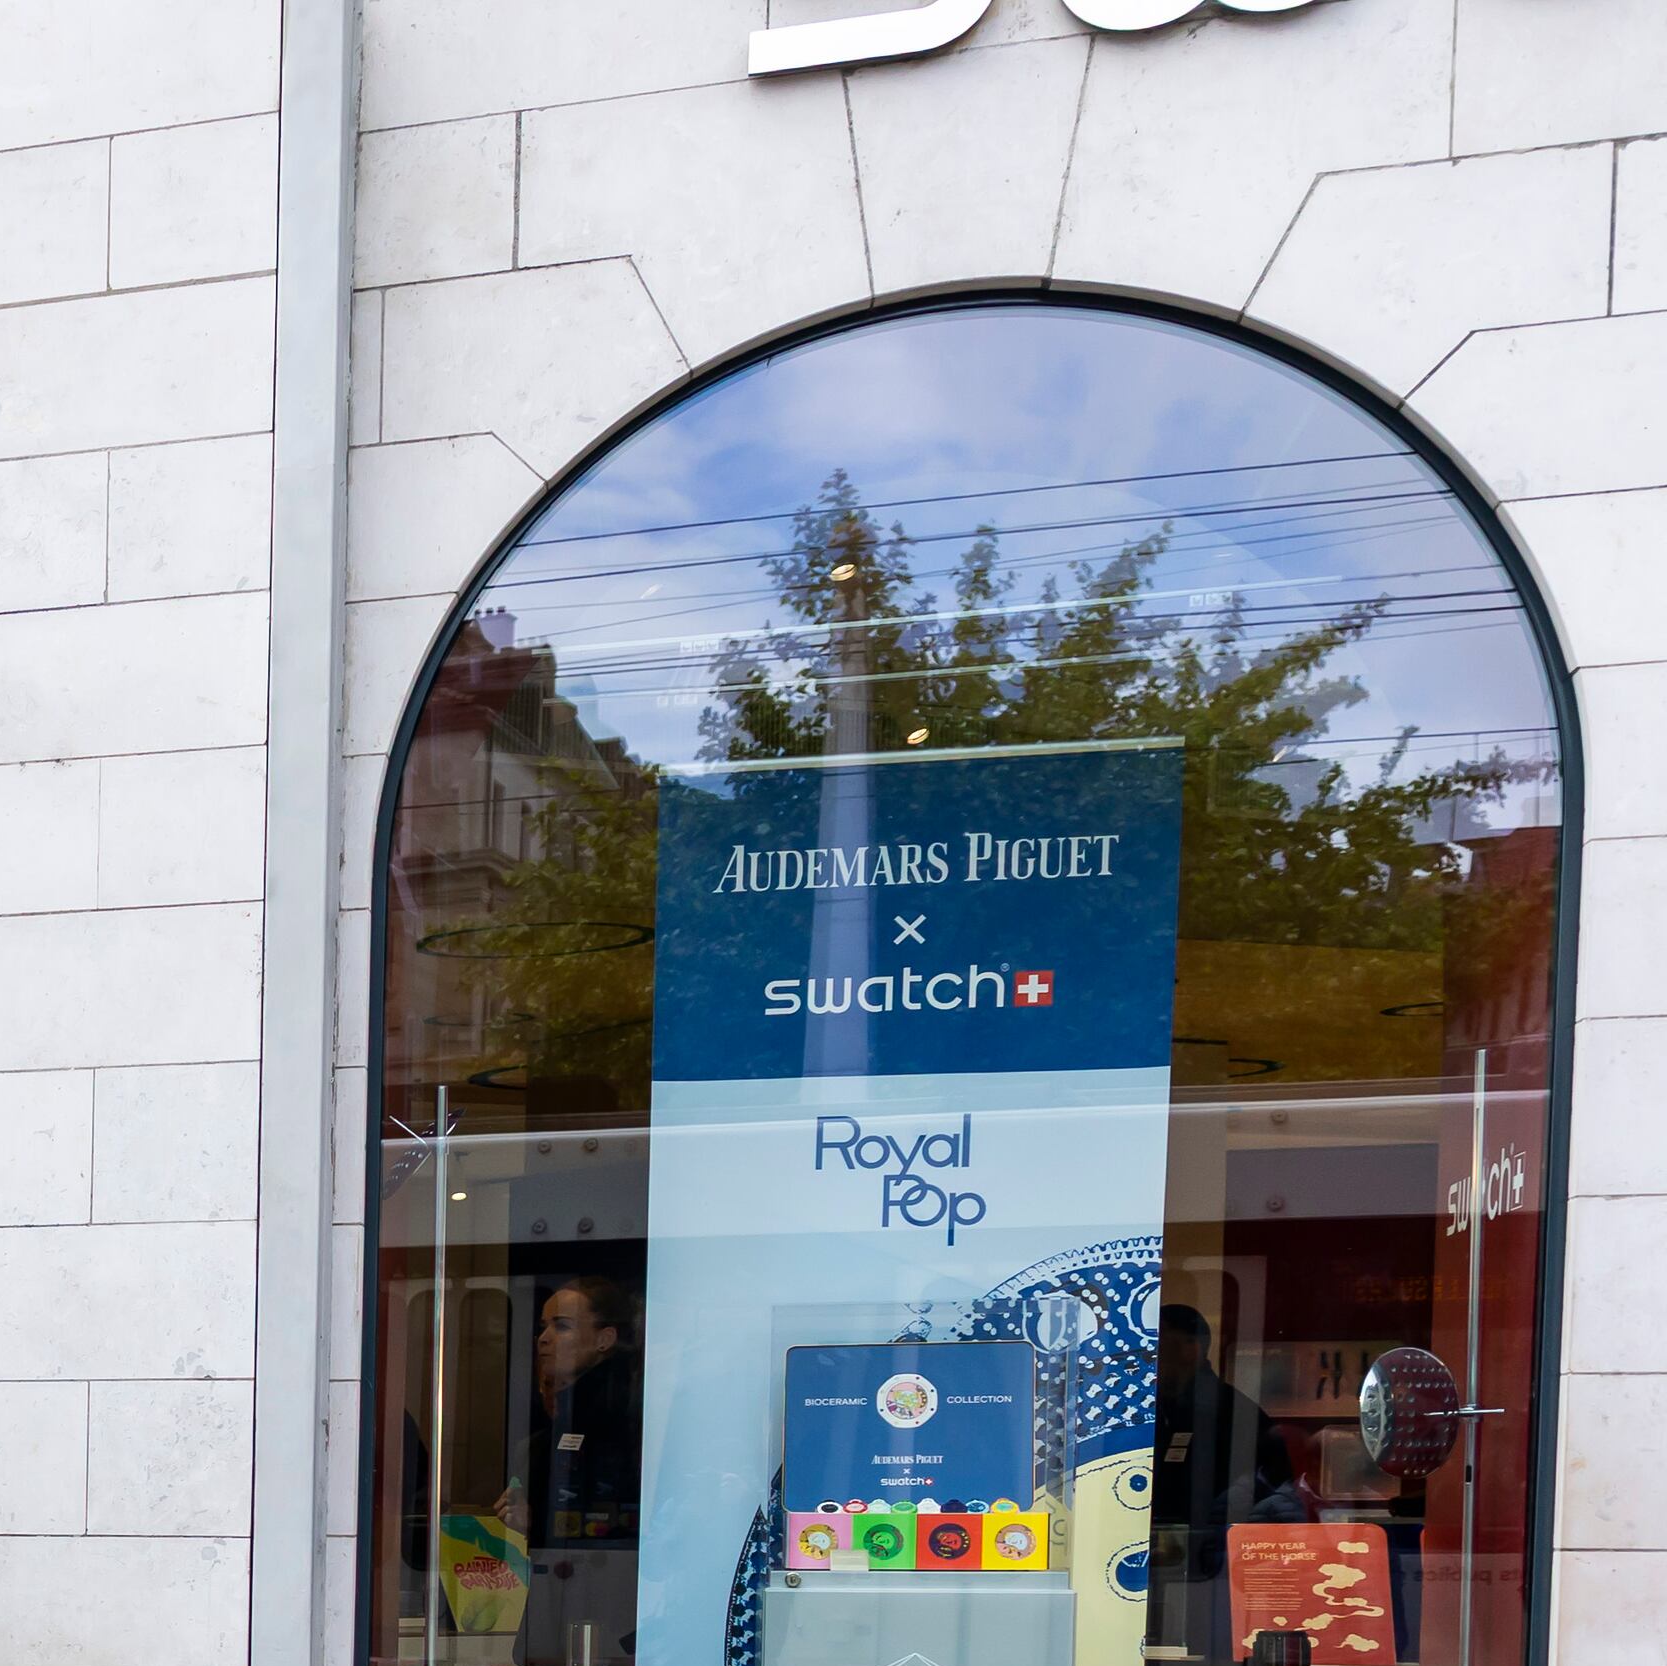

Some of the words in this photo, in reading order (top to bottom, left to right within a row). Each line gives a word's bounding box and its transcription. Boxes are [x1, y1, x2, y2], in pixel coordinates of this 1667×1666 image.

[713, 843, 950, 895] AUDEMARS
[962, 832, 1120, 882] PIGUET
[815, 1113, 971, 1186] Royal
[1446, 1148, 1512, 1236] swch
[804, 1396, 868, 1407] BIOCERAMIC
[946, 1395, 1013, 1405] COLLECTION
[916, 1453, 944, 1464] PIGUET
[880, 1477, 925, 1486] swatch
[1242, 1542, 1276, 1550] HAPPY
[1278, 1542, 1306, 1550] YEAR
[1242, 1553, 1257, 1561] OF
[1258, 1552, 1278, 1560] THE
[1281, 1552, 1317, 1561] HORSE
